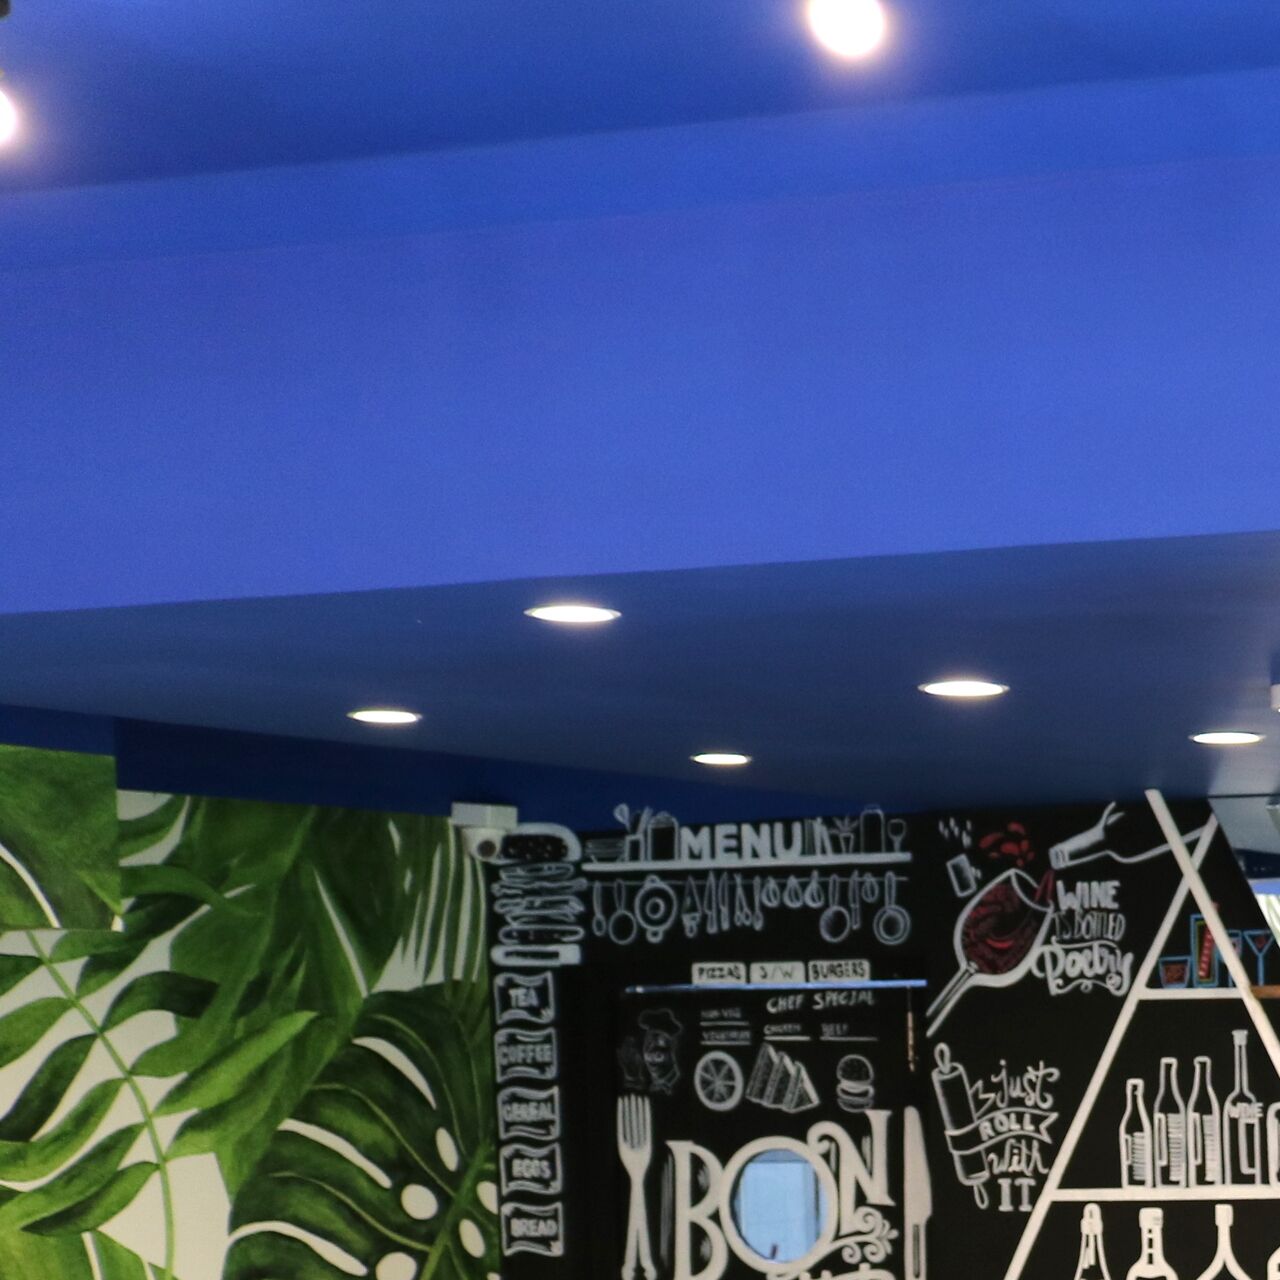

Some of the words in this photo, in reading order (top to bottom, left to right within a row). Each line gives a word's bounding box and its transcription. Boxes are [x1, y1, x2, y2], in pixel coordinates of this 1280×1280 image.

[679, 821, 802, 860] MENU
[1056, 880, 1121, 910] WINE
[810, 961, 868, 980] BURGERS
[978, 1111, 1036, 1142] ROLL
[997, 1177, 1037, 1212] IT
